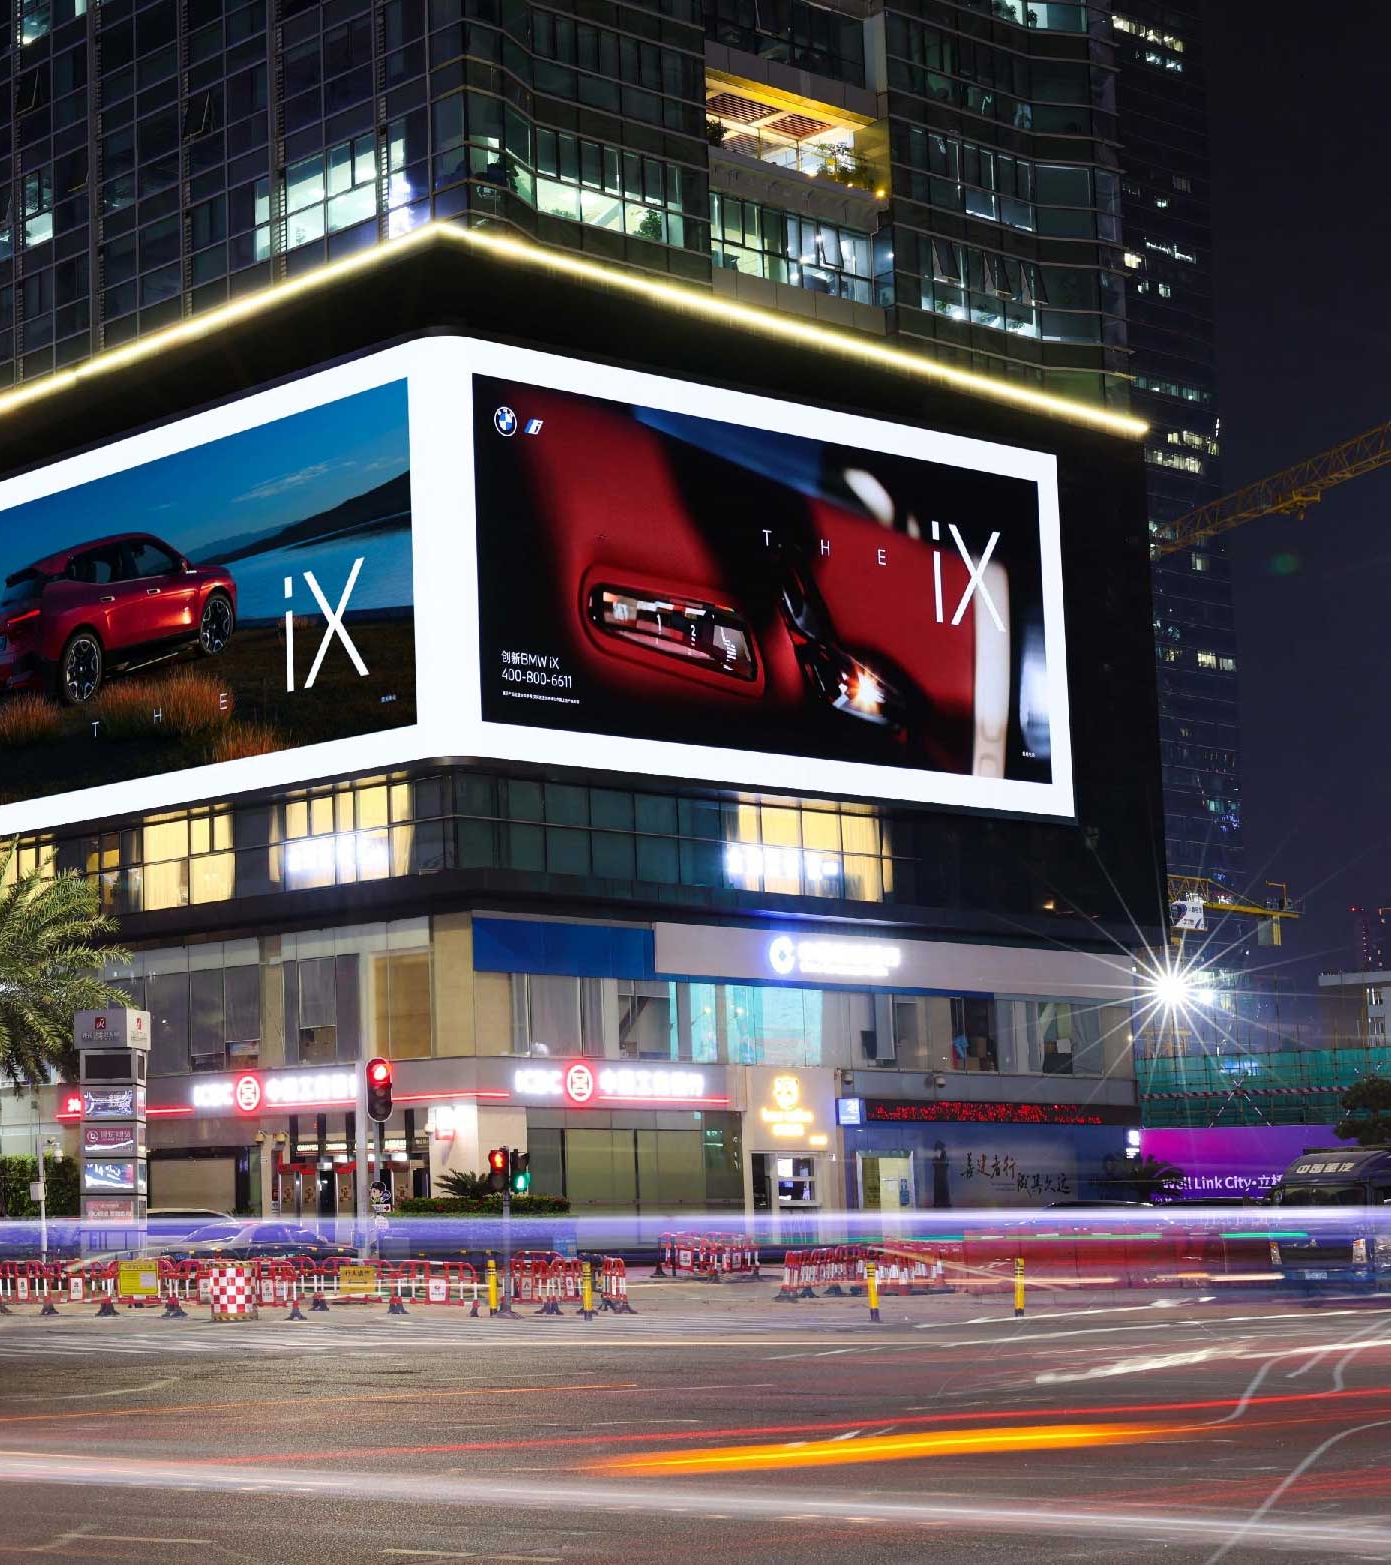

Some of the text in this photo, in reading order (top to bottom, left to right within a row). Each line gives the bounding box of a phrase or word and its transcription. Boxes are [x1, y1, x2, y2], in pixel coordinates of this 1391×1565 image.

[284, 557, 369, 692] iX
[931, 520, 1007, 632] iX
[1194, 1175, 1223, 1190] Link
